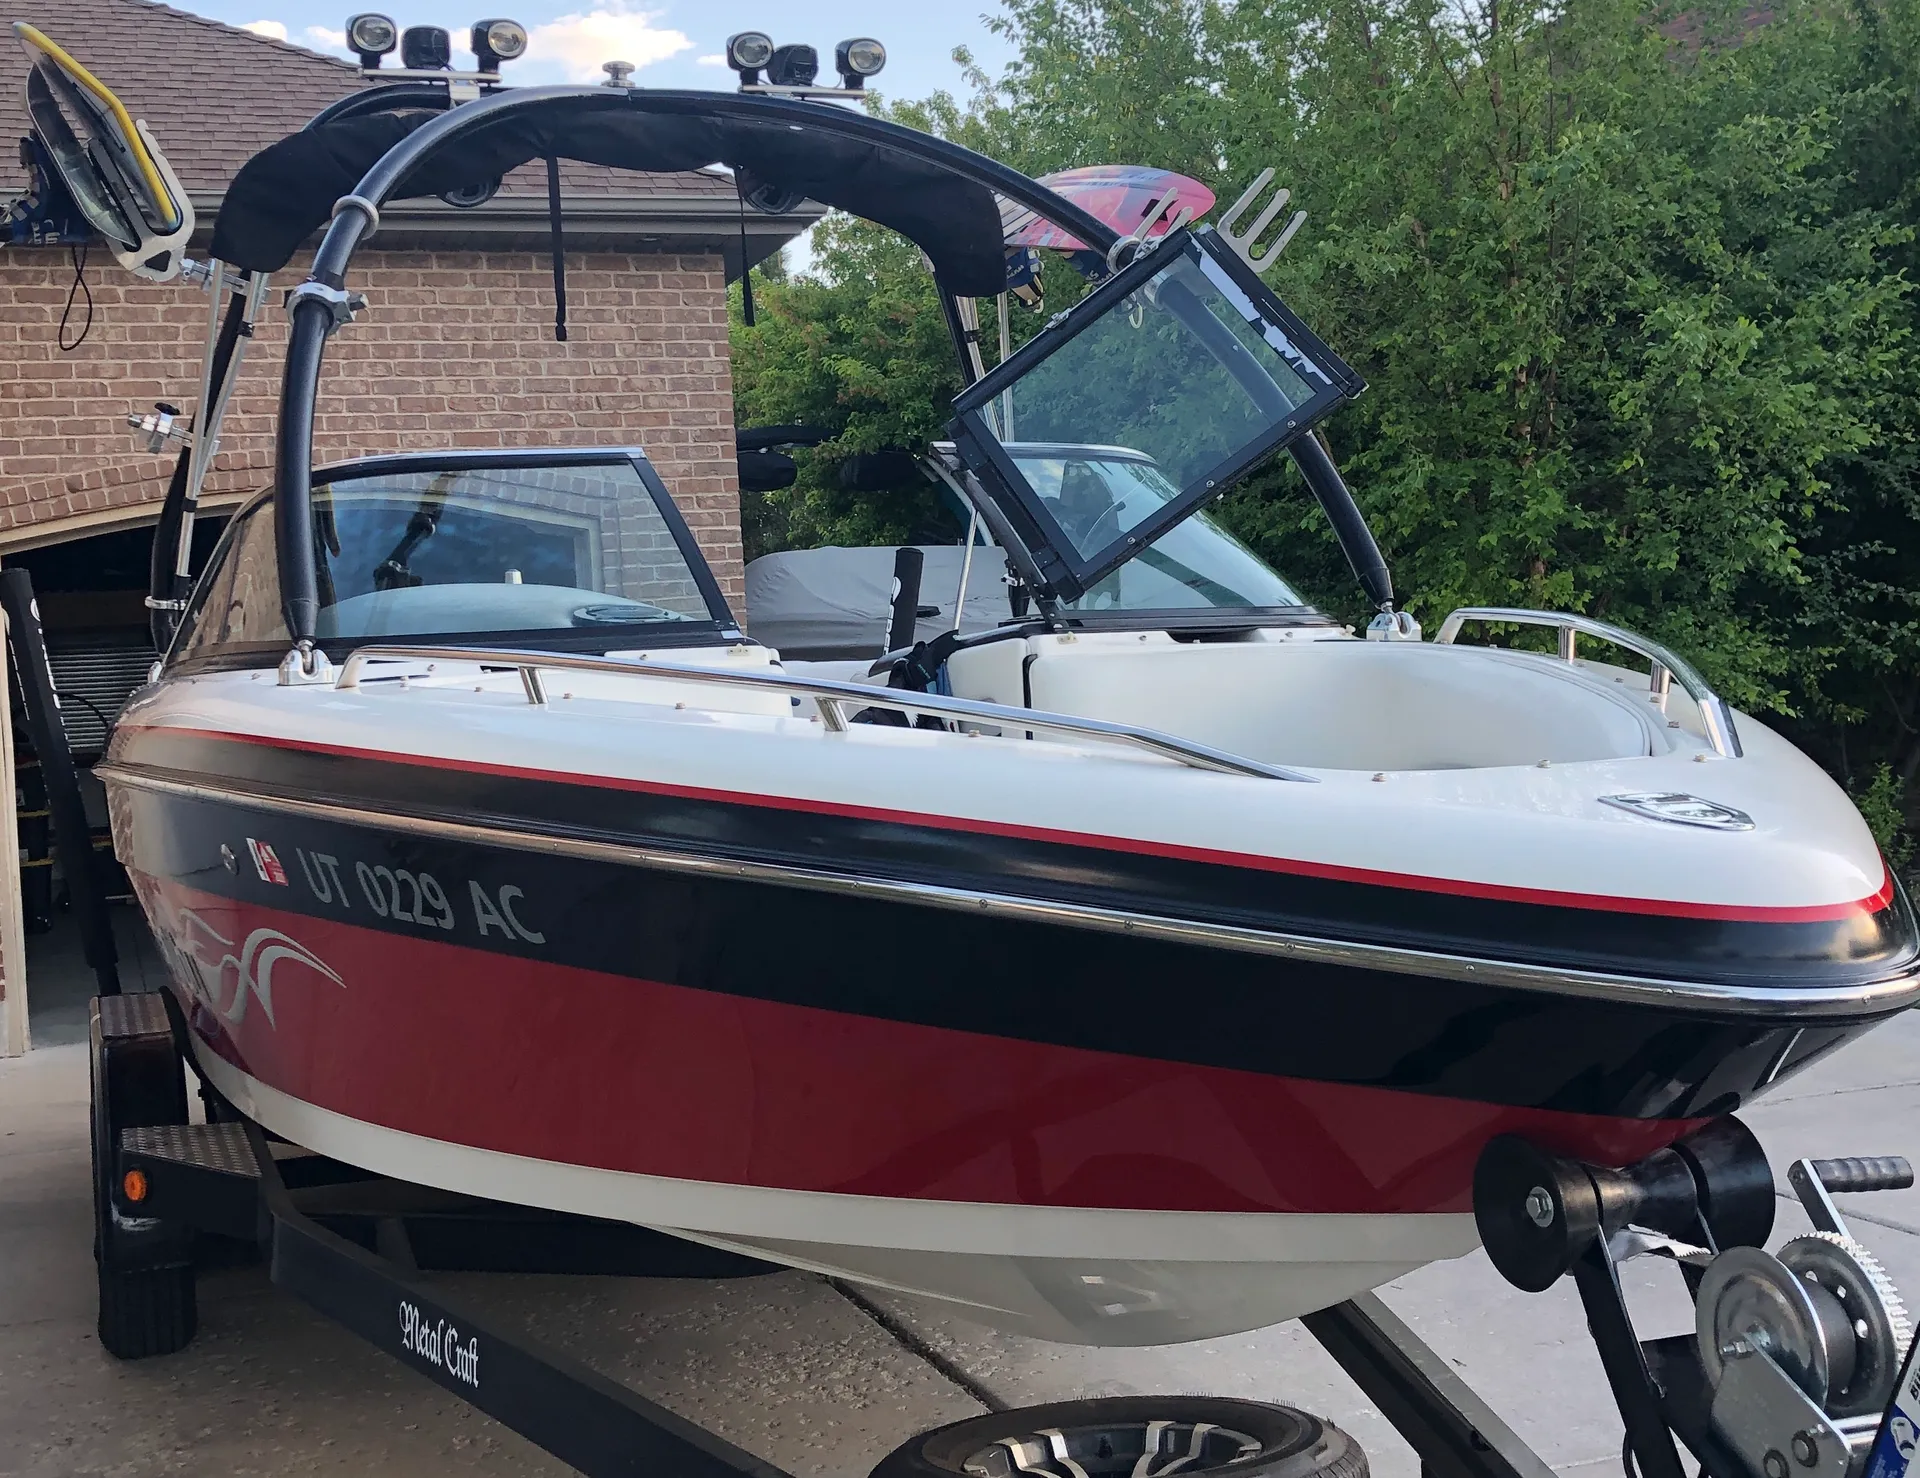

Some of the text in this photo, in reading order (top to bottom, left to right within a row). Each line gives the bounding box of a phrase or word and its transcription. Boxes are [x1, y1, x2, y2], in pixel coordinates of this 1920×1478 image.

[296, 848, 349, 907] UT
[356, 861, 455, 929] 0229
[468, 880, 546, 944] AC
[399, 1301, 479, 1388] Metal Craft
